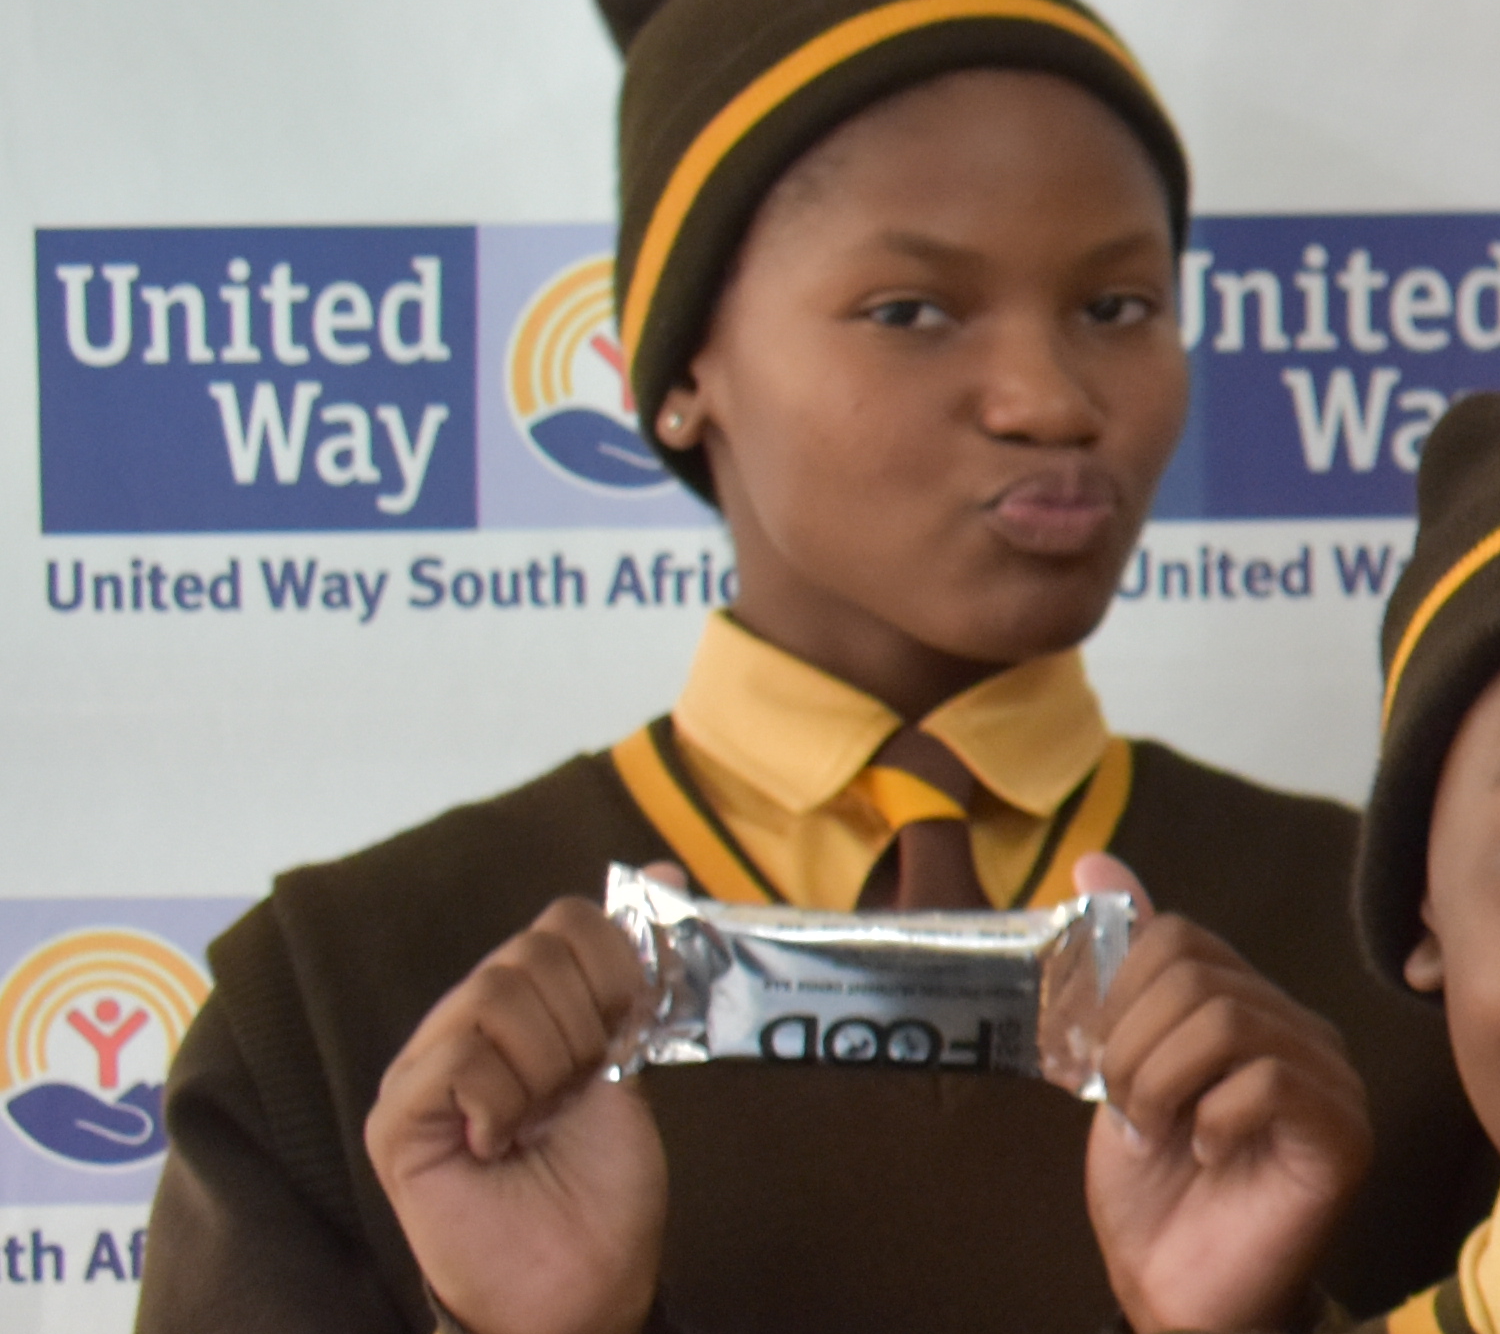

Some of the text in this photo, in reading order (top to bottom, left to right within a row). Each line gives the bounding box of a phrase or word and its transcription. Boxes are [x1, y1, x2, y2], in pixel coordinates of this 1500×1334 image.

[56, 257, 450, 367] United
[209, 382, 449, 515] Way
[1283, 367, 1446, 472] Wa
[46, 558, 242, 615] United
[260, 557, 389, 623] Way
[408, 553, 586, 609] South
